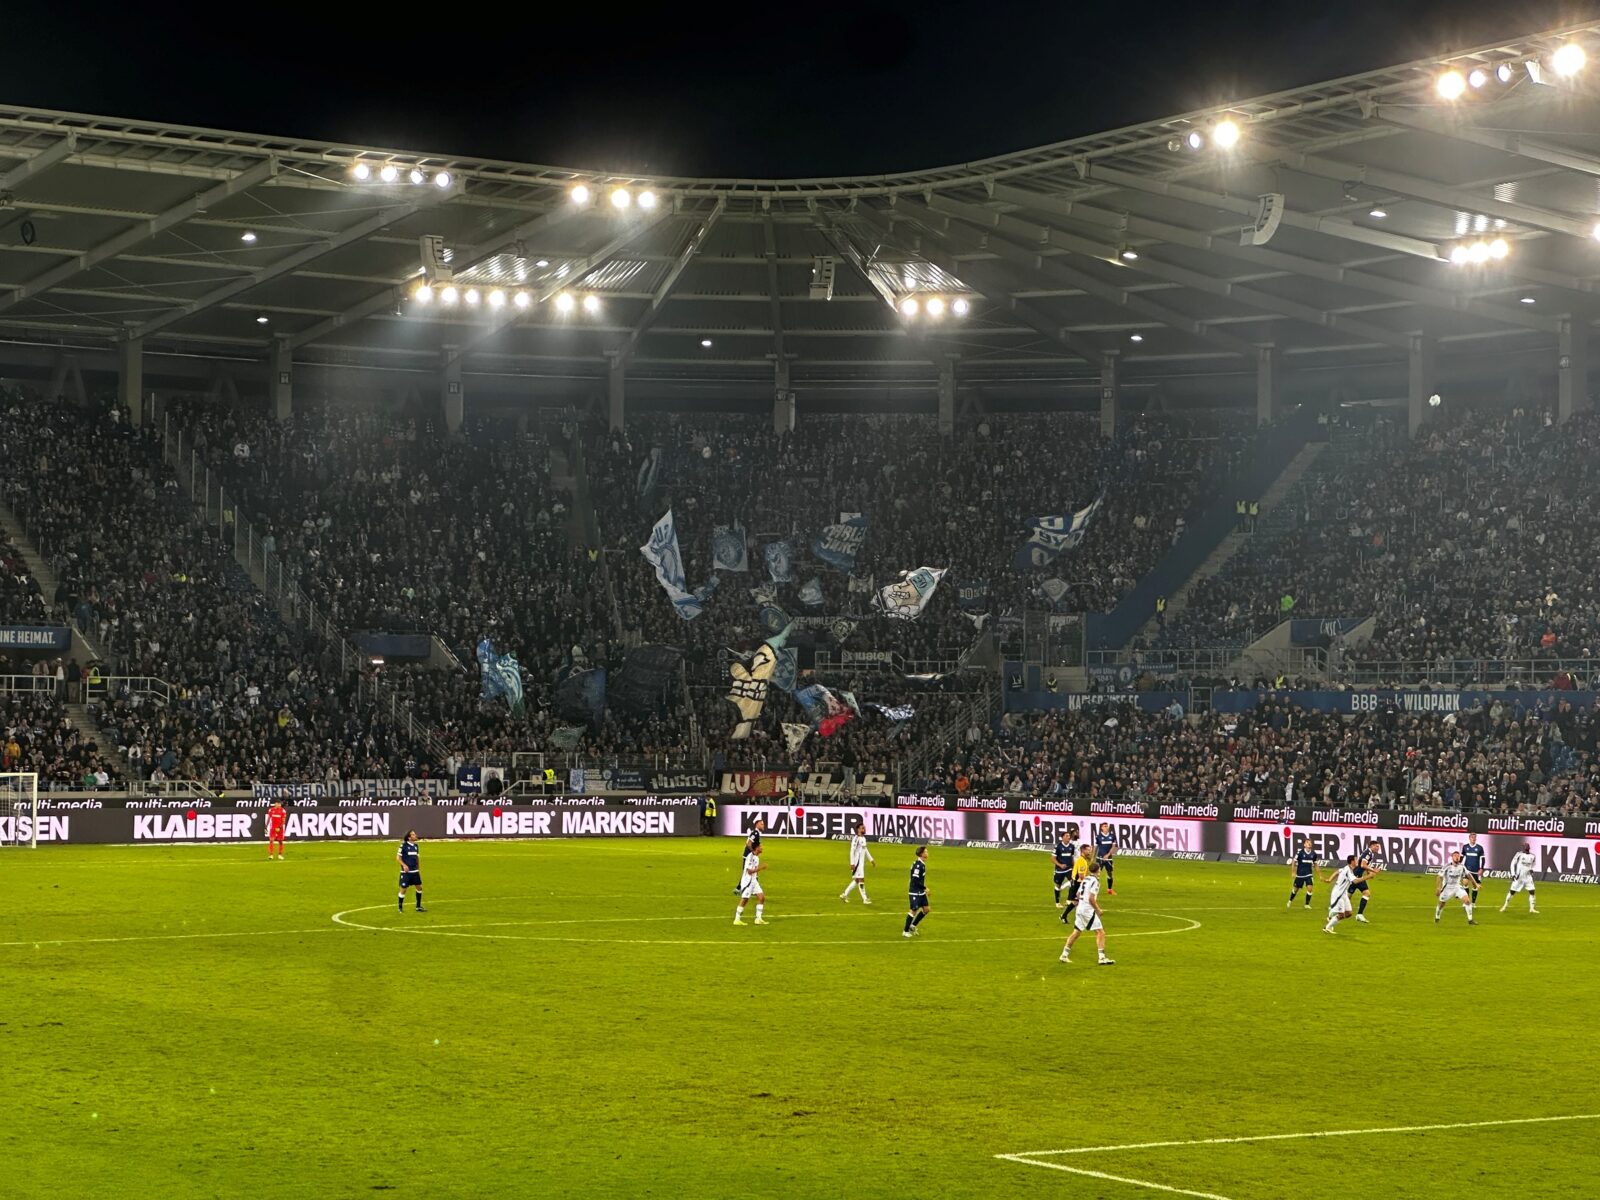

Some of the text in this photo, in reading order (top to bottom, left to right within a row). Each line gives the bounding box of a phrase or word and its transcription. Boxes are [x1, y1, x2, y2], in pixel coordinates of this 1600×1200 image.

[17, 631, 56, 644] HEIMAT.
[1404, 694, 1460, 711] WILDPARK
[897, 794, 945, 807] multi-media
[957, 796, 1007, 810] multi-media
[1020, 799, 1074, 812] multi-media
[1160, 803, 1219, 817] multi-media
[1312, 809, 1379, 824] multi-media
[562, 811, 675, 834] MARKISEN
[873, 813, 954, 840] MARKISEN
[1398, 812, 1469, 828] multi-media
[1487, 816, 1565, 833] multi-media
